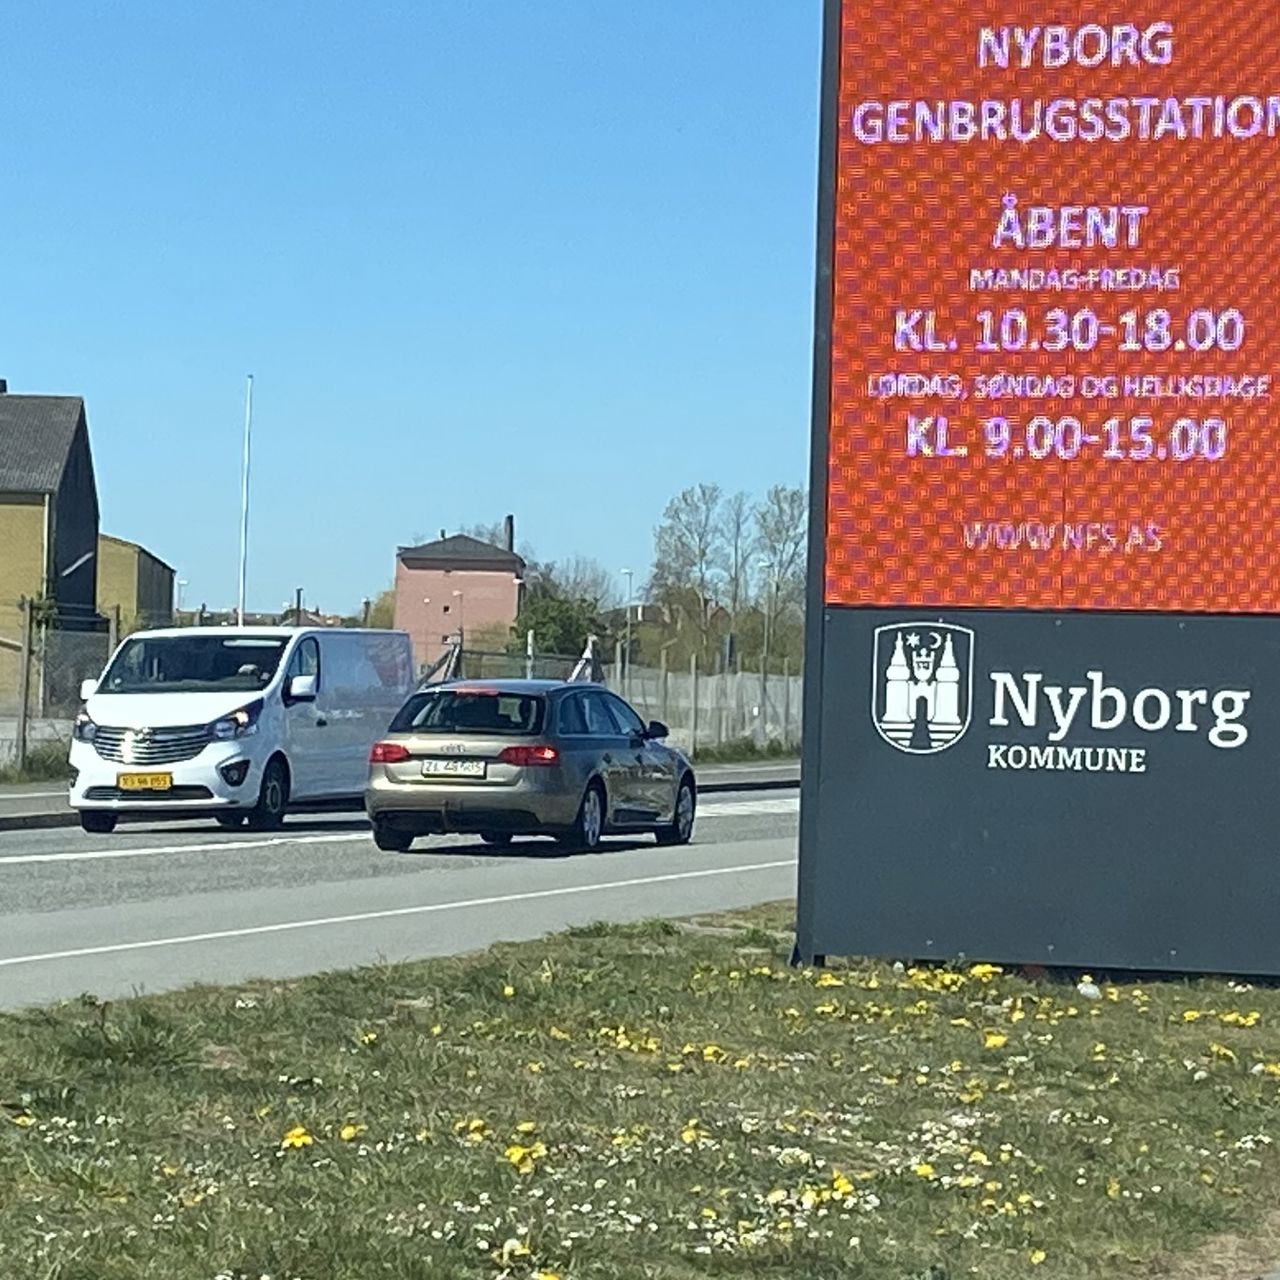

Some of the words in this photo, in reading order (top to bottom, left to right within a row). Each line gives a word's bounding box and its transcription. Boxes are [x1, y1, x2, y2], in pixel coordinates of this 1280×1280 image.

[977, 22, 1174, 69] NYBORG
[992, 192, 1149, 249] ÅBENT
[969, 267, 1181, 292] MANDAG-FREDAG
[894, 309, 958, 352] KL.
[975, 308, 1246, 352] 10.30-18.00
[974, 370, 1074, 399] SØNDAG
[1080, 373, 1118, 399] OG
[905, 415, 969, 458] KL.
[983, 416, 1227, 461] 9.00-15.00
[988, 670, 1252, 749] Nyborg
[987, 745, 1147, 773] KOMMUNE
